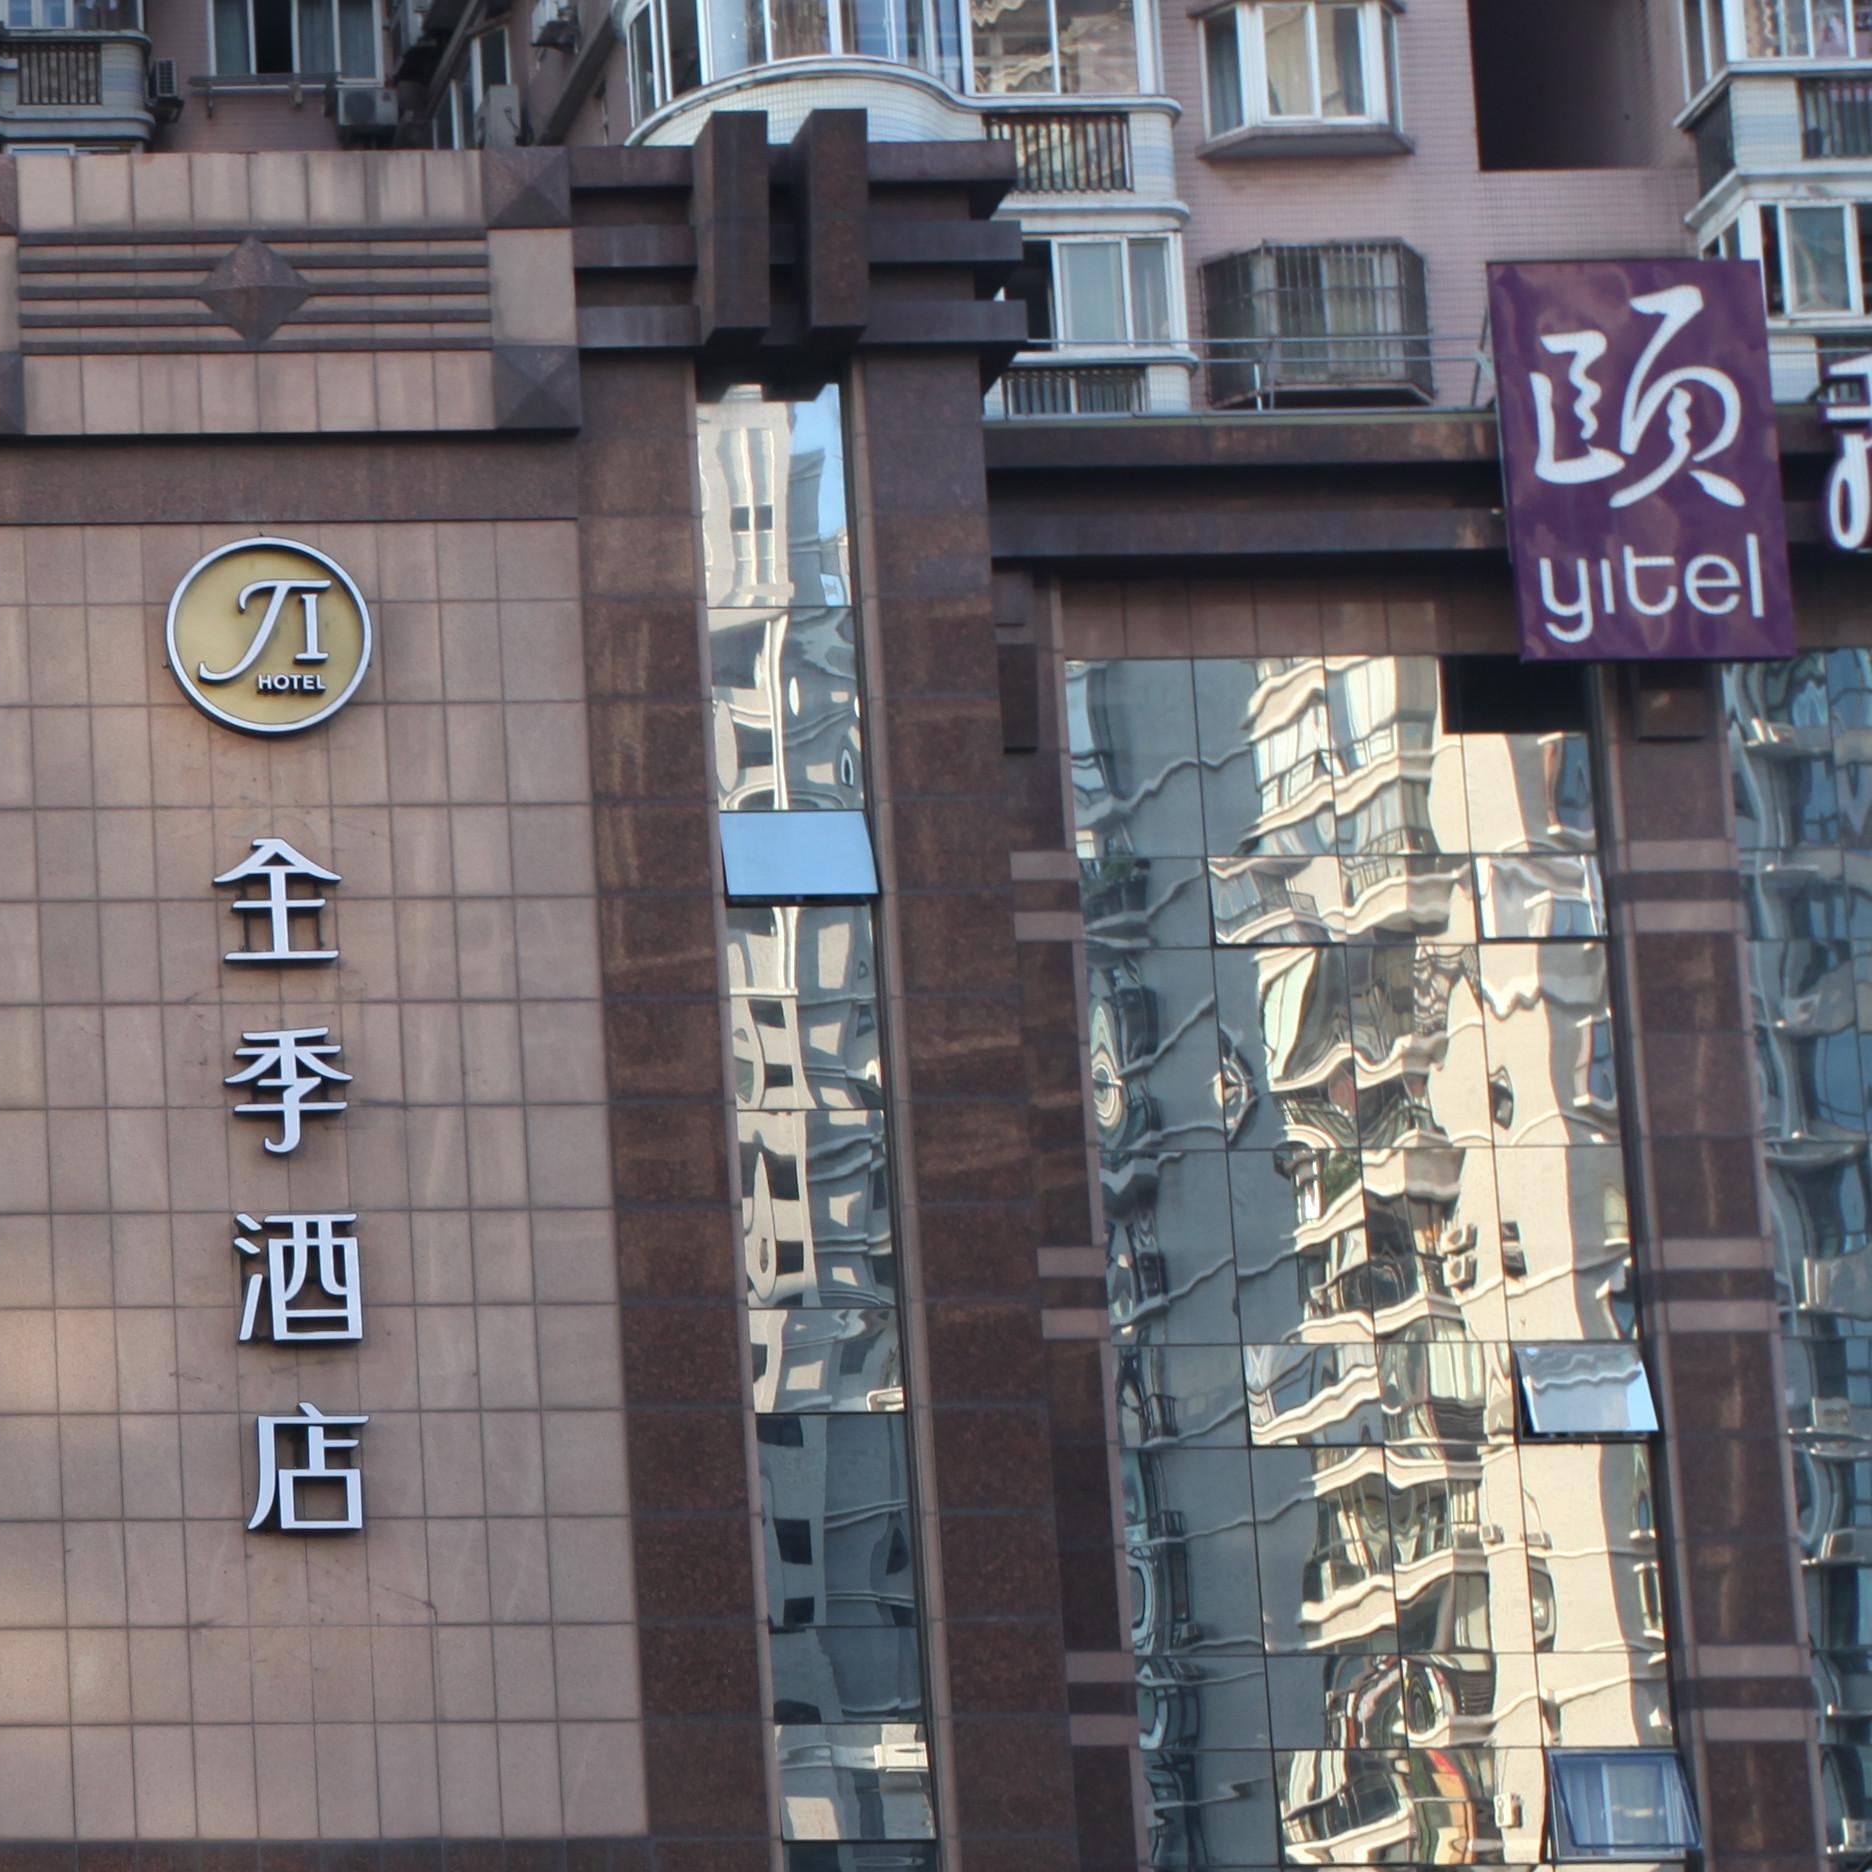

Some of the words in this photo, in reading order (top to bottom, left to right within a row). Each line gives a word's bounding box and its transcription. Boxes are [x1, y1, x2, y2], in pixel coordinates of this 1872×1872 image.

[1539, 533, 1764, 643] yitel
[256, 673, 327, 693] HOTEL
[212, 837, 370, 1532] 全季酒店
